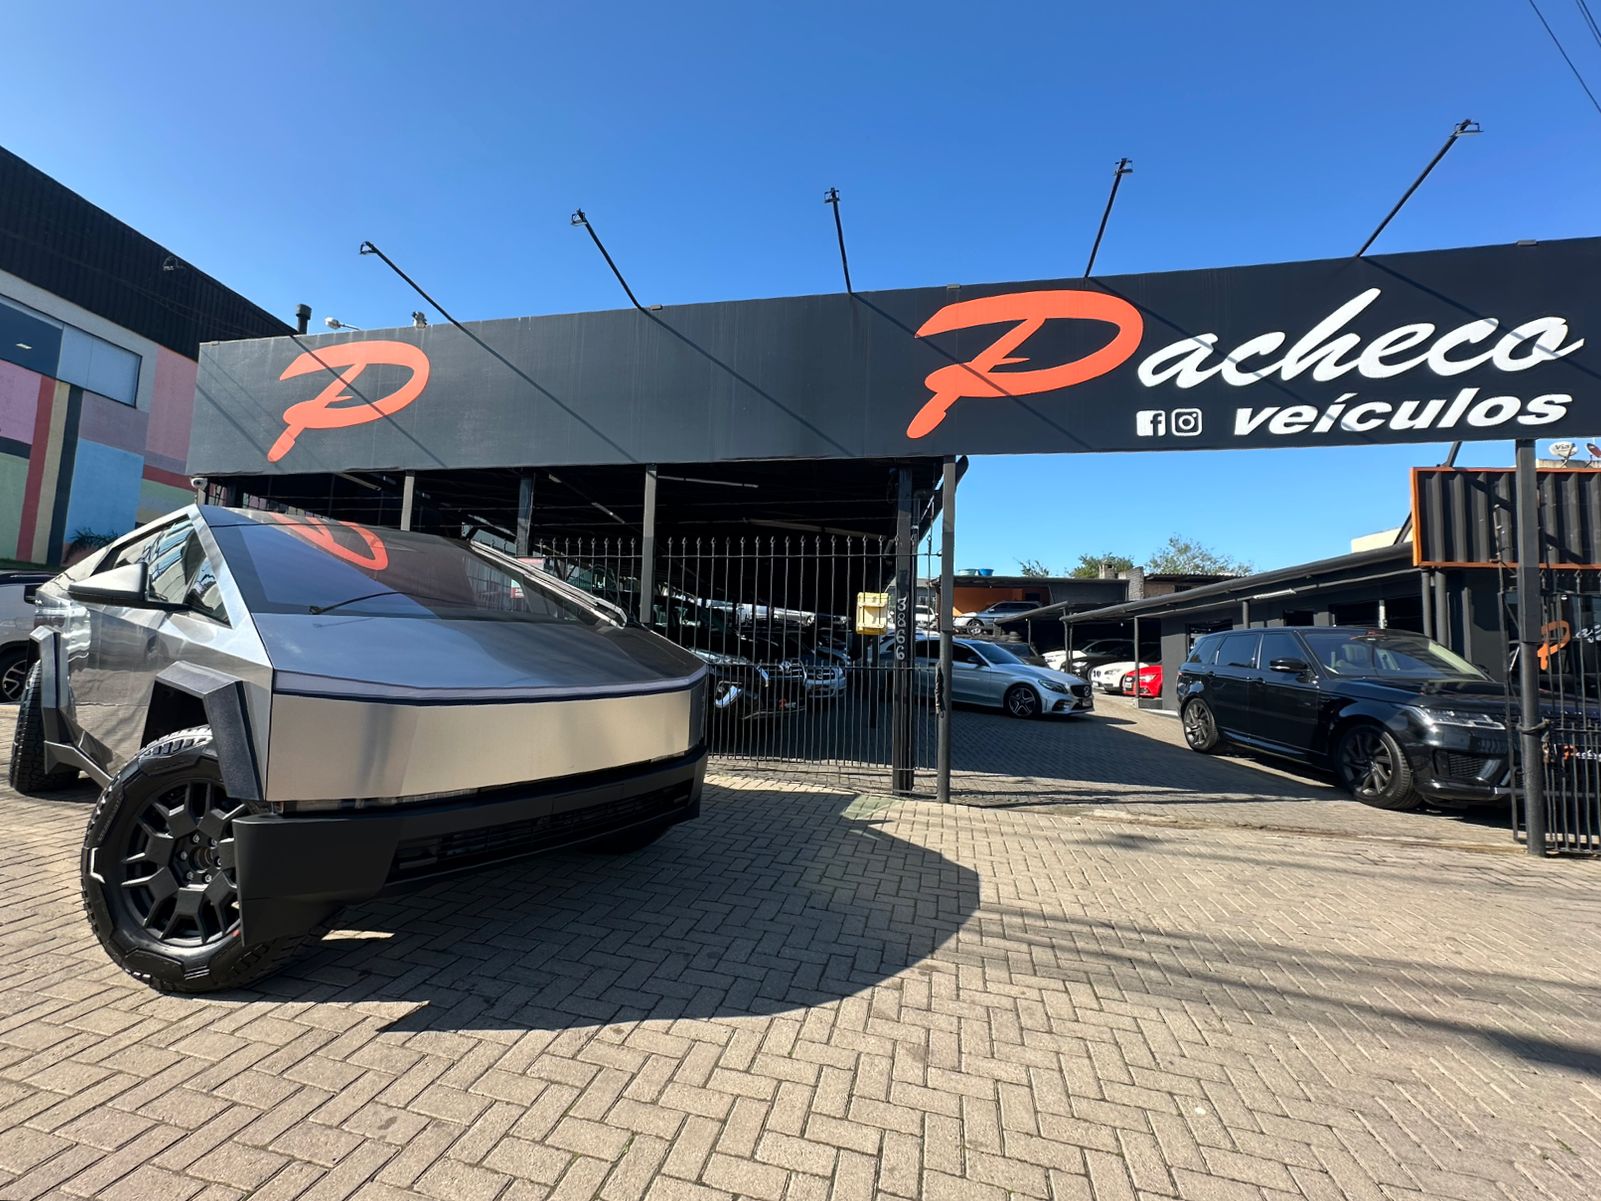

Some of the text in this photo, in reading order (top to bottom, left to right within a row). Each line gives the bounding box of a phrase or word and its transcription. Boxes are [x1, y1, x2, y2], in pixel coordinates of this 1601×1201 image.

[267, 340, 430, 462] P
[907, 288, 1584, 438] Pacheco
[1234, 388, 1572, 435] veículos
[896, 597, 908, 660] 3866
